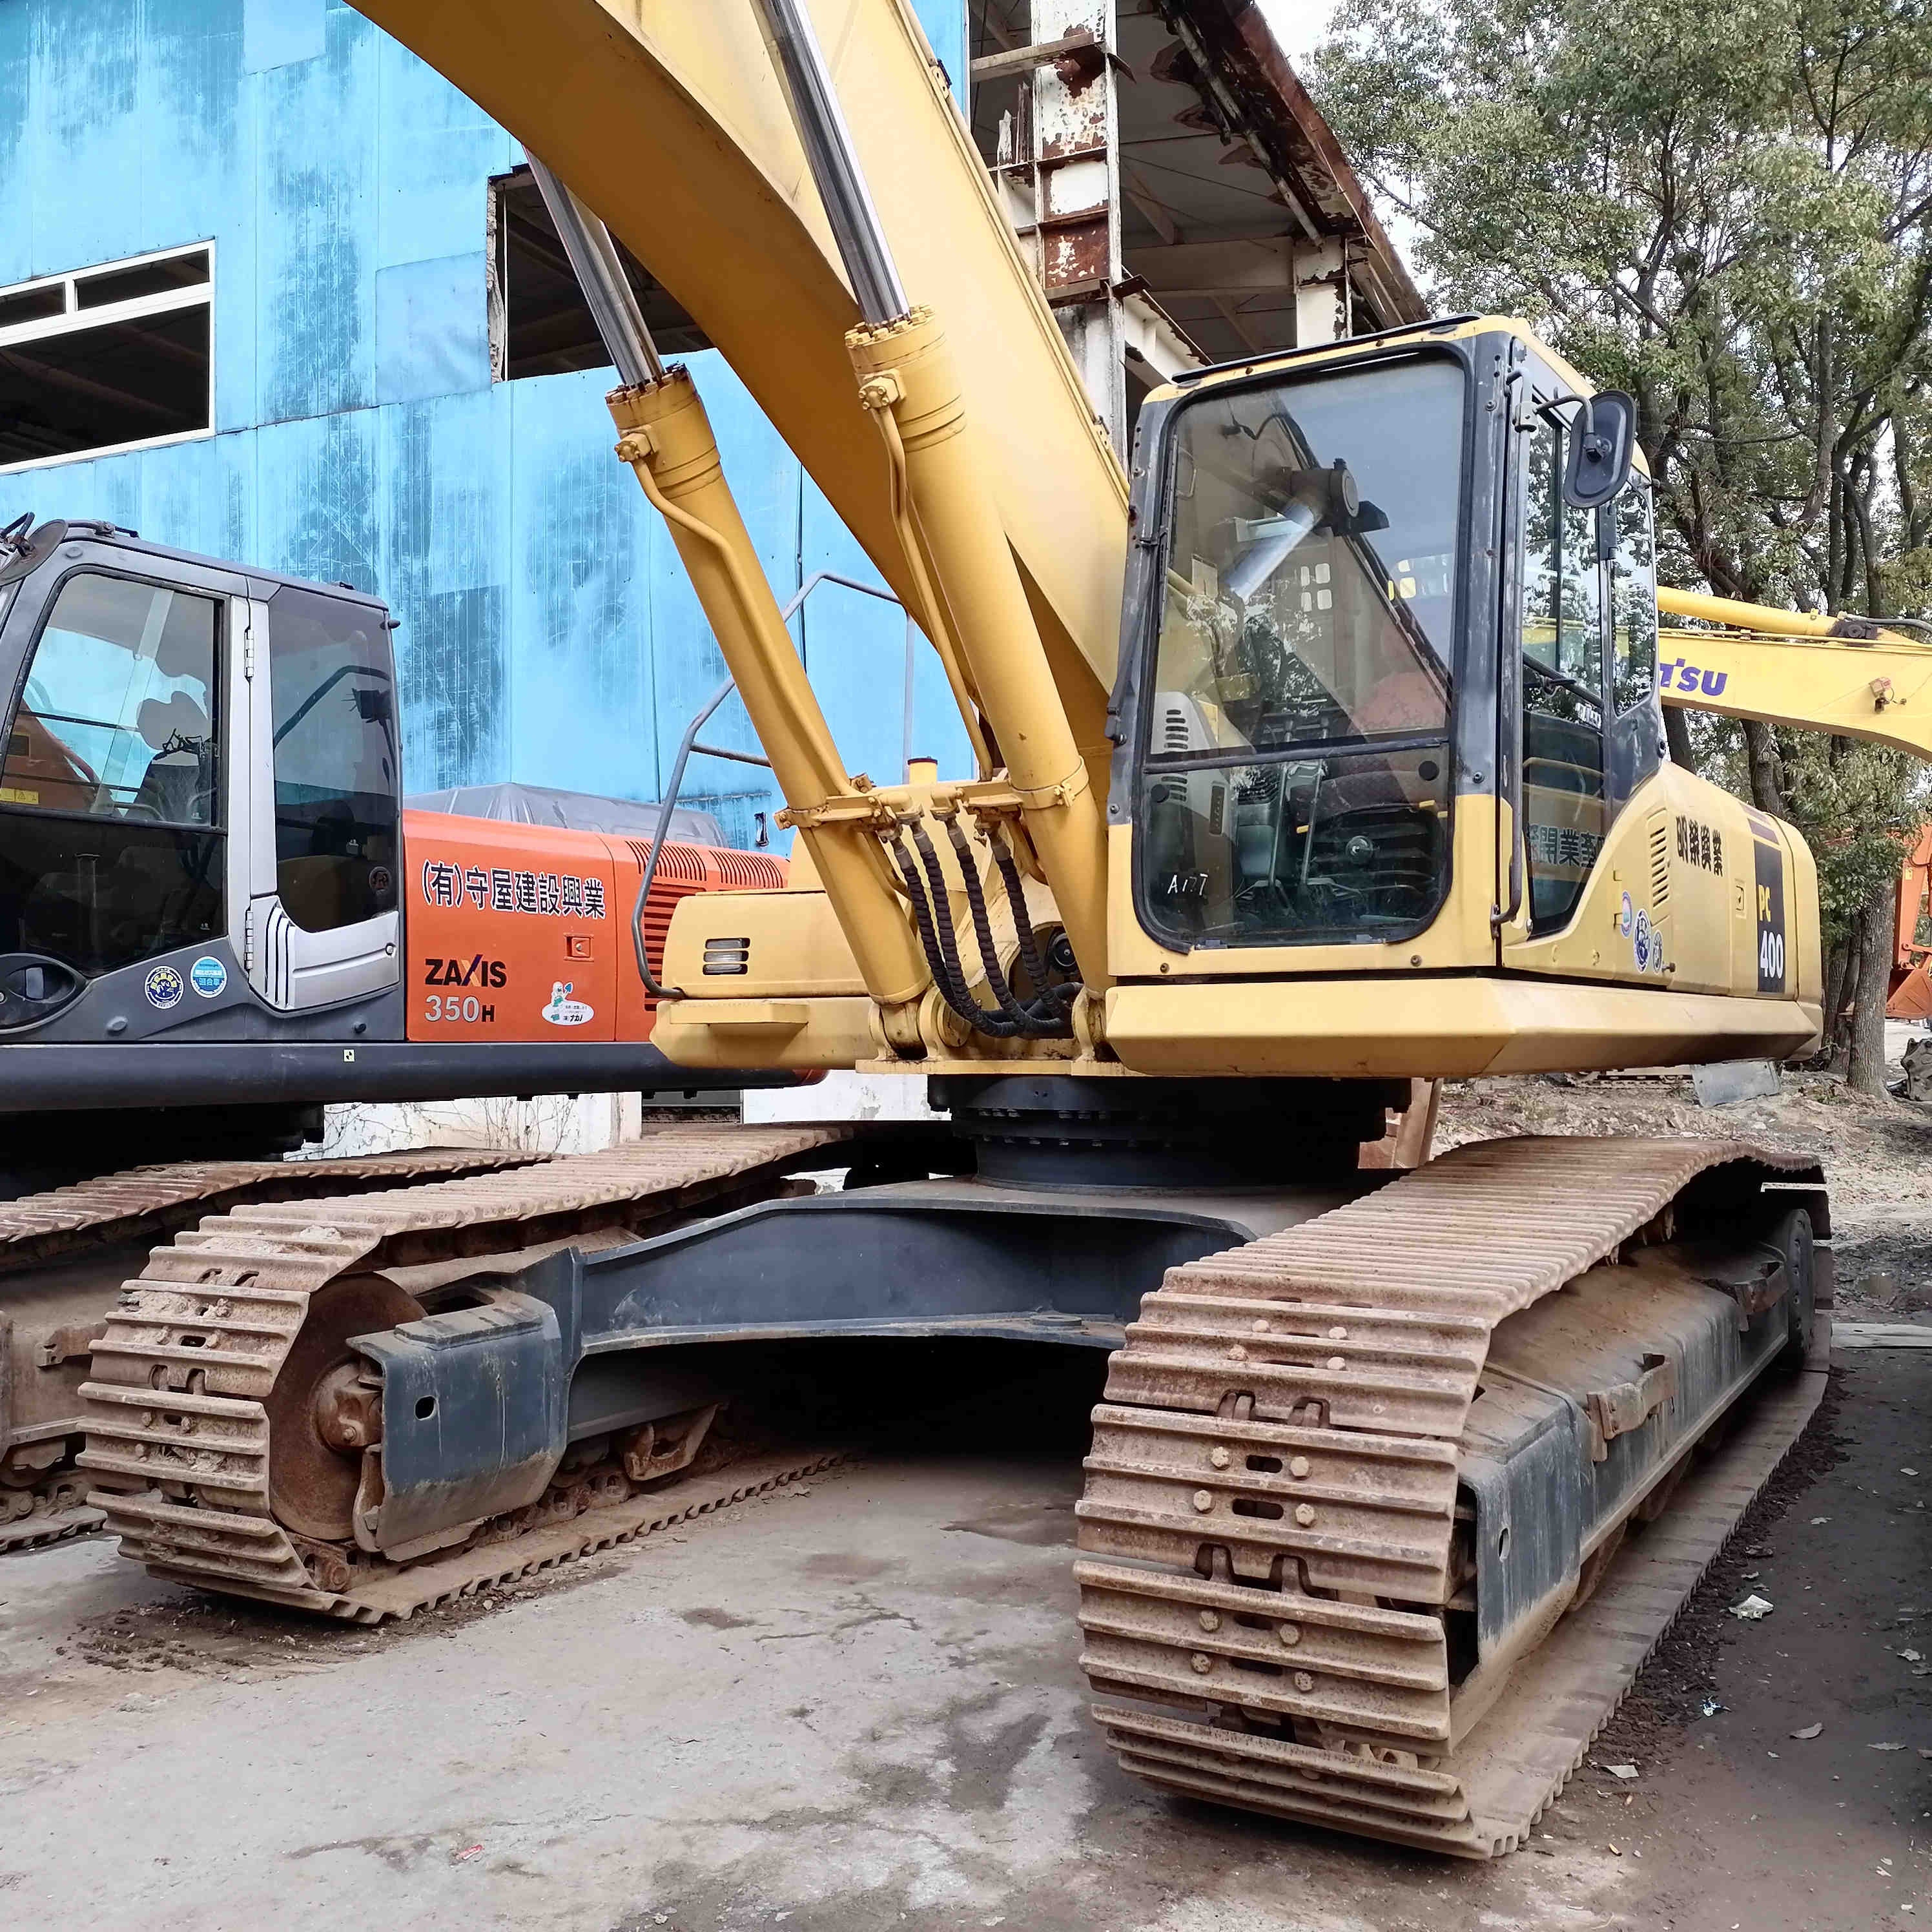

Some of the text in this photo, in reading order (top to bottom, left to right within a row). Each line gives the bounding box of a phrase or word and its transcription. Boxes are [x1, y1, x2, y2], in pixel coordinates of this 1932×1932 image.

[422, 859, 606, 920] (有)守屋建設興業
[1758, 884, 1771, 923] PC
[425, 954, 508, 988] ZAXIS
[1760, 930, 1784, 979] 400
